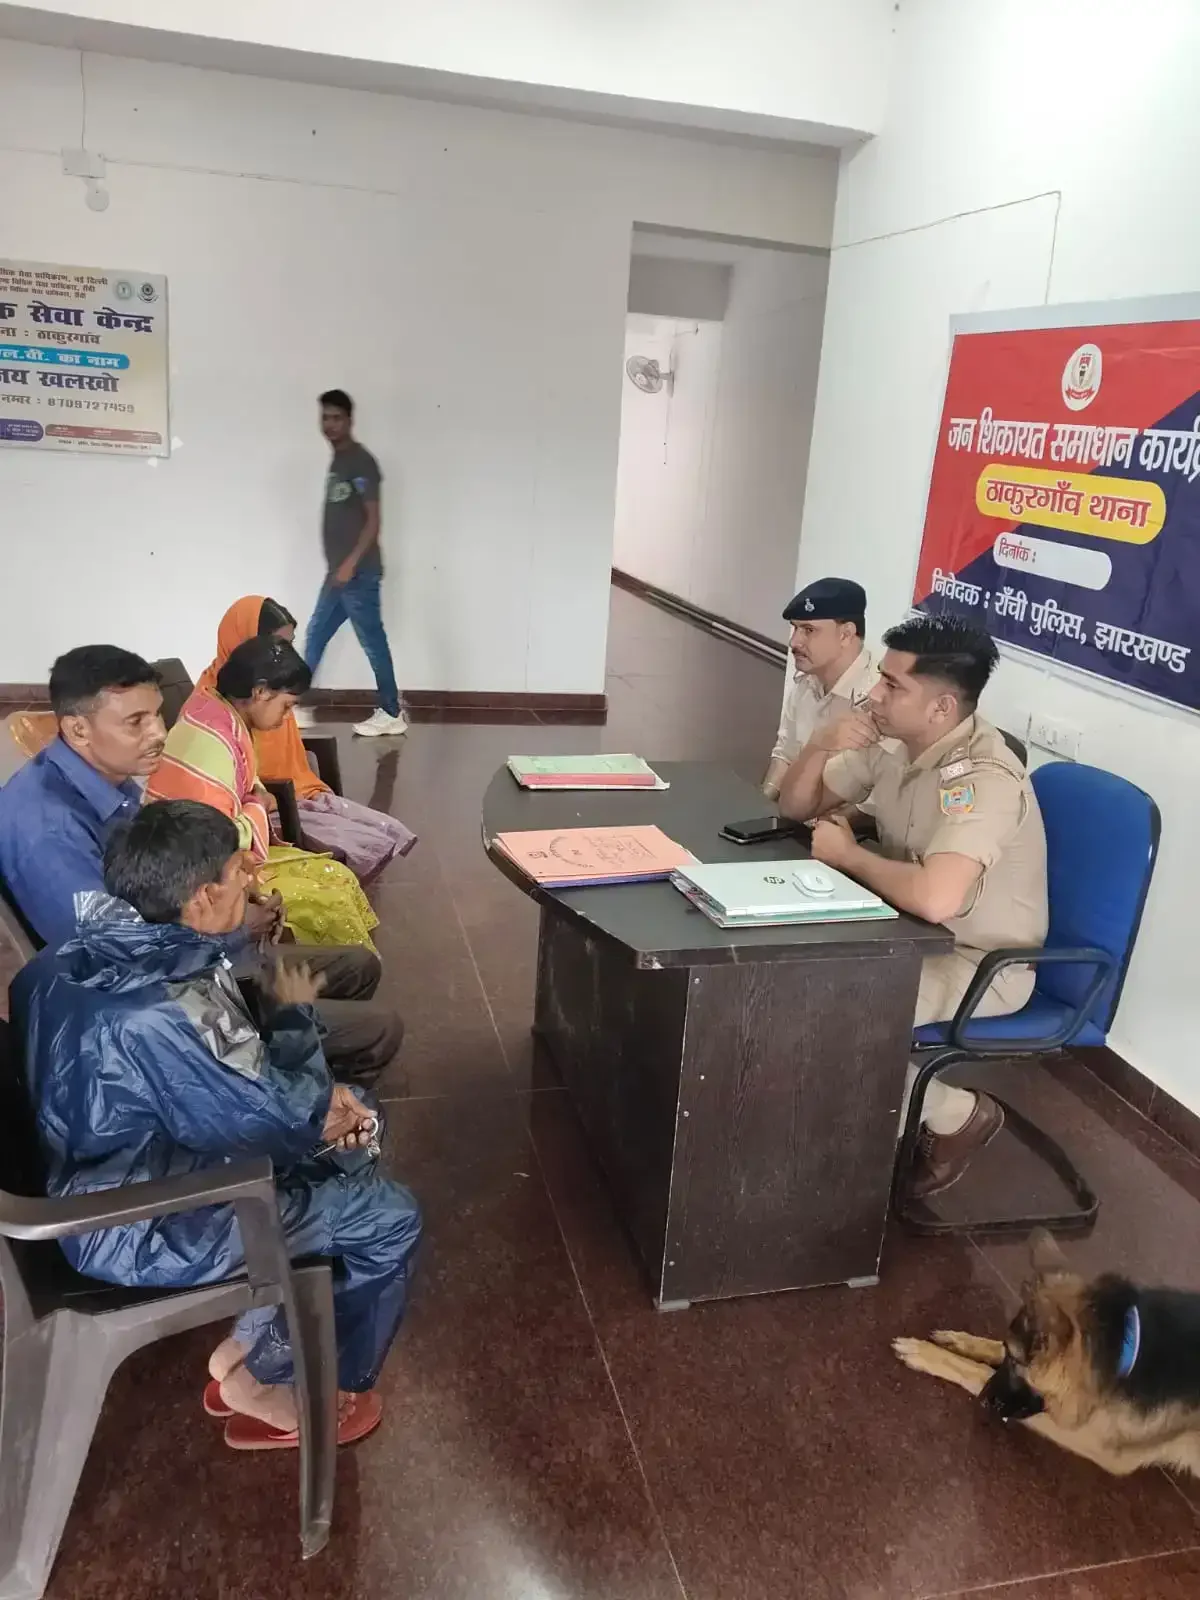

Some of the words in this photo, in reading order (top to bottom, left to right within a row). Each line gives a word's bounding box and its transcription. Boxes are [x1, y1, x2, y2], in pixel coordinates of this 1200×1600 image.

[27, 300, 85, 326] सेवा
[93, 306, 155, 333] केन्द्र
[36, 329, 103, 345] ठाकुरगांव
[57, 352, 82, 365] का
[86, 355, 121, 368] नाम
[36, 372, 120, 393] खलखो
[948, 417, 978, 452] जन
[976, 406, 1051, 460] शिकायत
[1050, 422, 1139, 469] समाधान
[985, 479, 1085, 517] ठाकुरगाँव
[1089, 494, 1152, 528] थाना
[997, 537, 1032, 563] दिनांक
[930, 567, 983, 607] निवेदक
[994, 586, 1029, 623] राँची
[1029, 598, 1088, 645] पुलिस,
[1093, 620, 1192, 674] झारखण्ड
